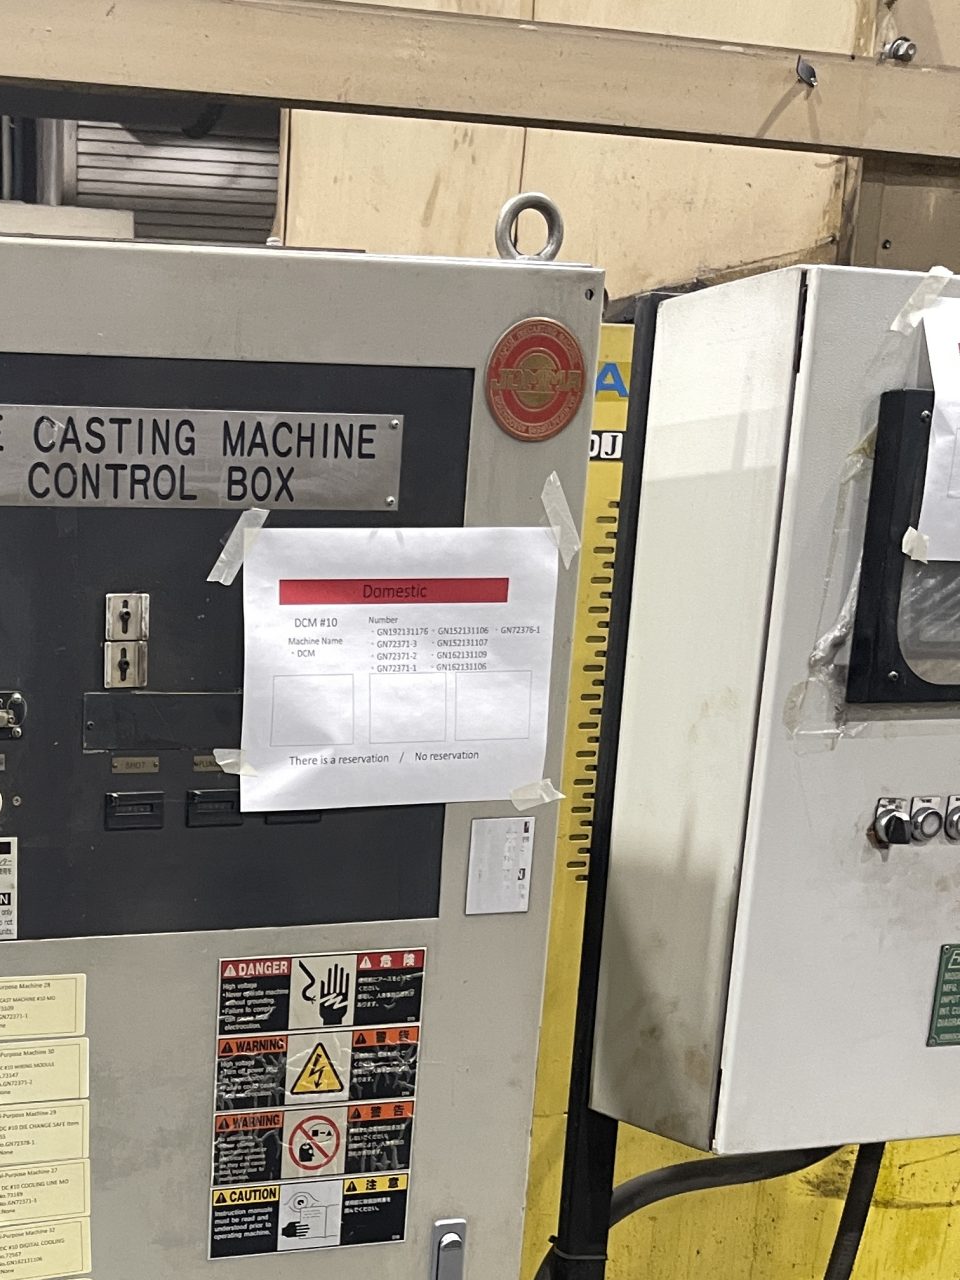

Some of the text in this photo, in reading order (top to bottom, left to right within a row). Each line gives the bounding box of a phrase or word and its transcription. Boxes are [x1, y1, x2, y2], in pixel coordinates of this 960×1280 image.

[33, 415, 196, 457] CASTING
[222, 420, 377, 460] MACHINE
[28, 462, 295, 502] CONTROL BOX
[362, 584, 428, 599] Domestic
[294, 618, 338, 628] DCM #10
[368, 616, 399, 624] Number
[288, 637, 344, 645] Machine Name
[289, 755, 318, 766] There
[320, 754, 328, 765] is
[329, 757, 336, 765] a
[338, 753, 389, 765] reservation
[415, 752, 427, 761] No
[430, 750, 479, 761] reservation
[239, 961, 288, 976] DANGER
[235, 1038, 284, 1053] WARNING
[232, 1114, 280, 1128] WARNING
[229, 1188, 276, 1202] CAUTION
